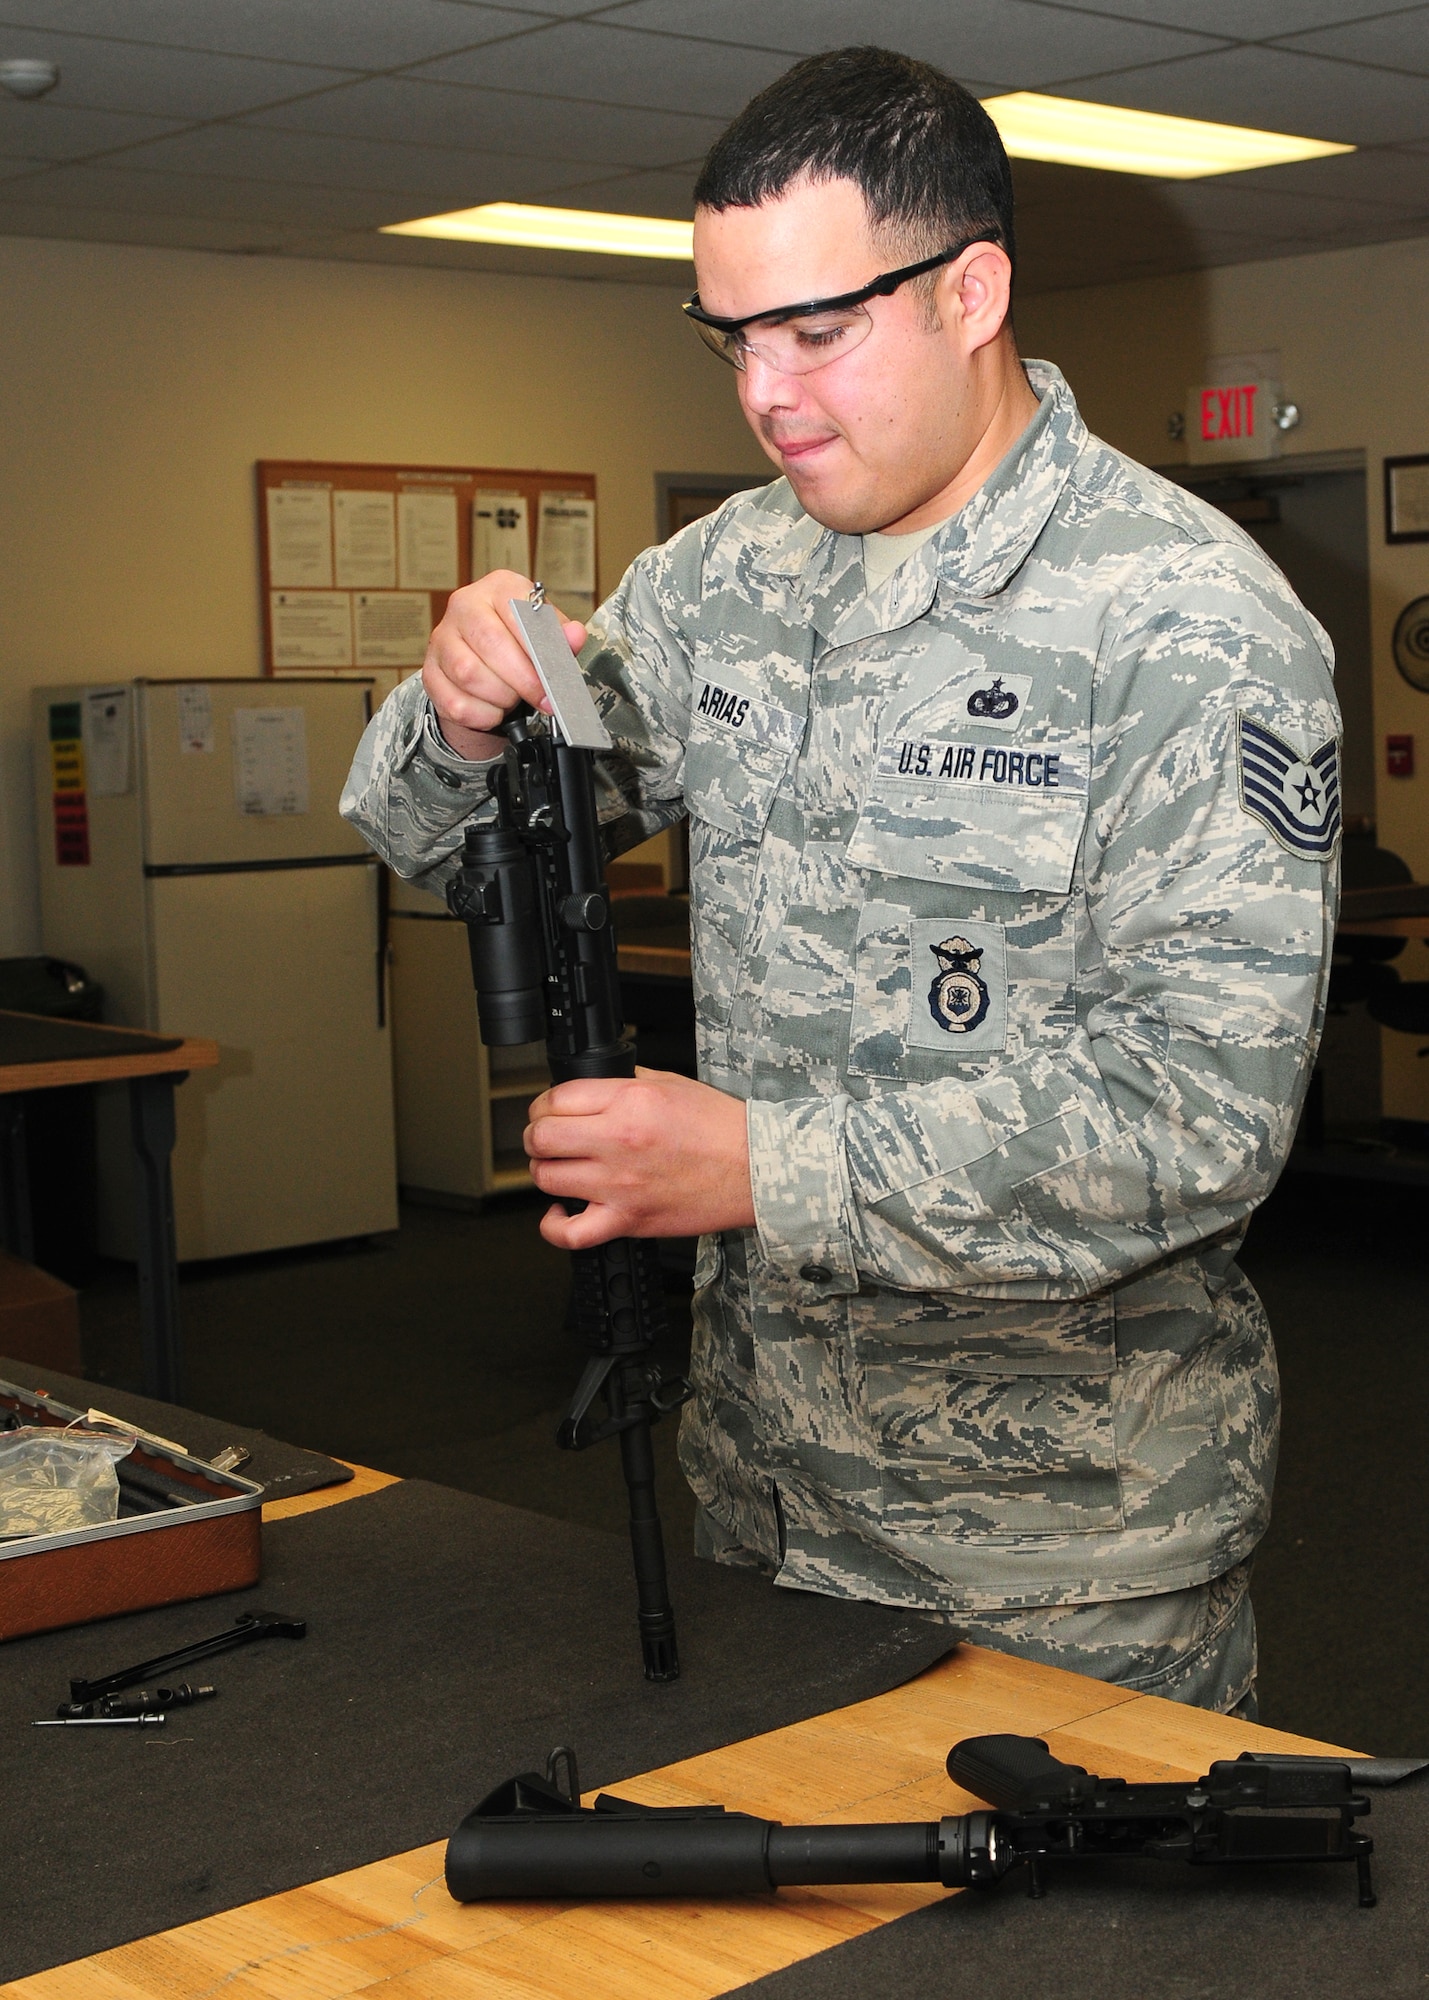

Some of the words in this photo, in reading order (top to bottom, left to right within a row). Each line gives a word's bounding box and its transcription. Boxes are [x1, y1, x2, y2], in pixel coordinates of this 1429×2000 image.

[1202, 384, 1257, 440] EXIT
[697, 684, 750, 728] ARIAS
[898, 743, 932, 776] U.S.
[939, 746, 976, 779] AIR
[979, 748, 1060, 787] FORCE
